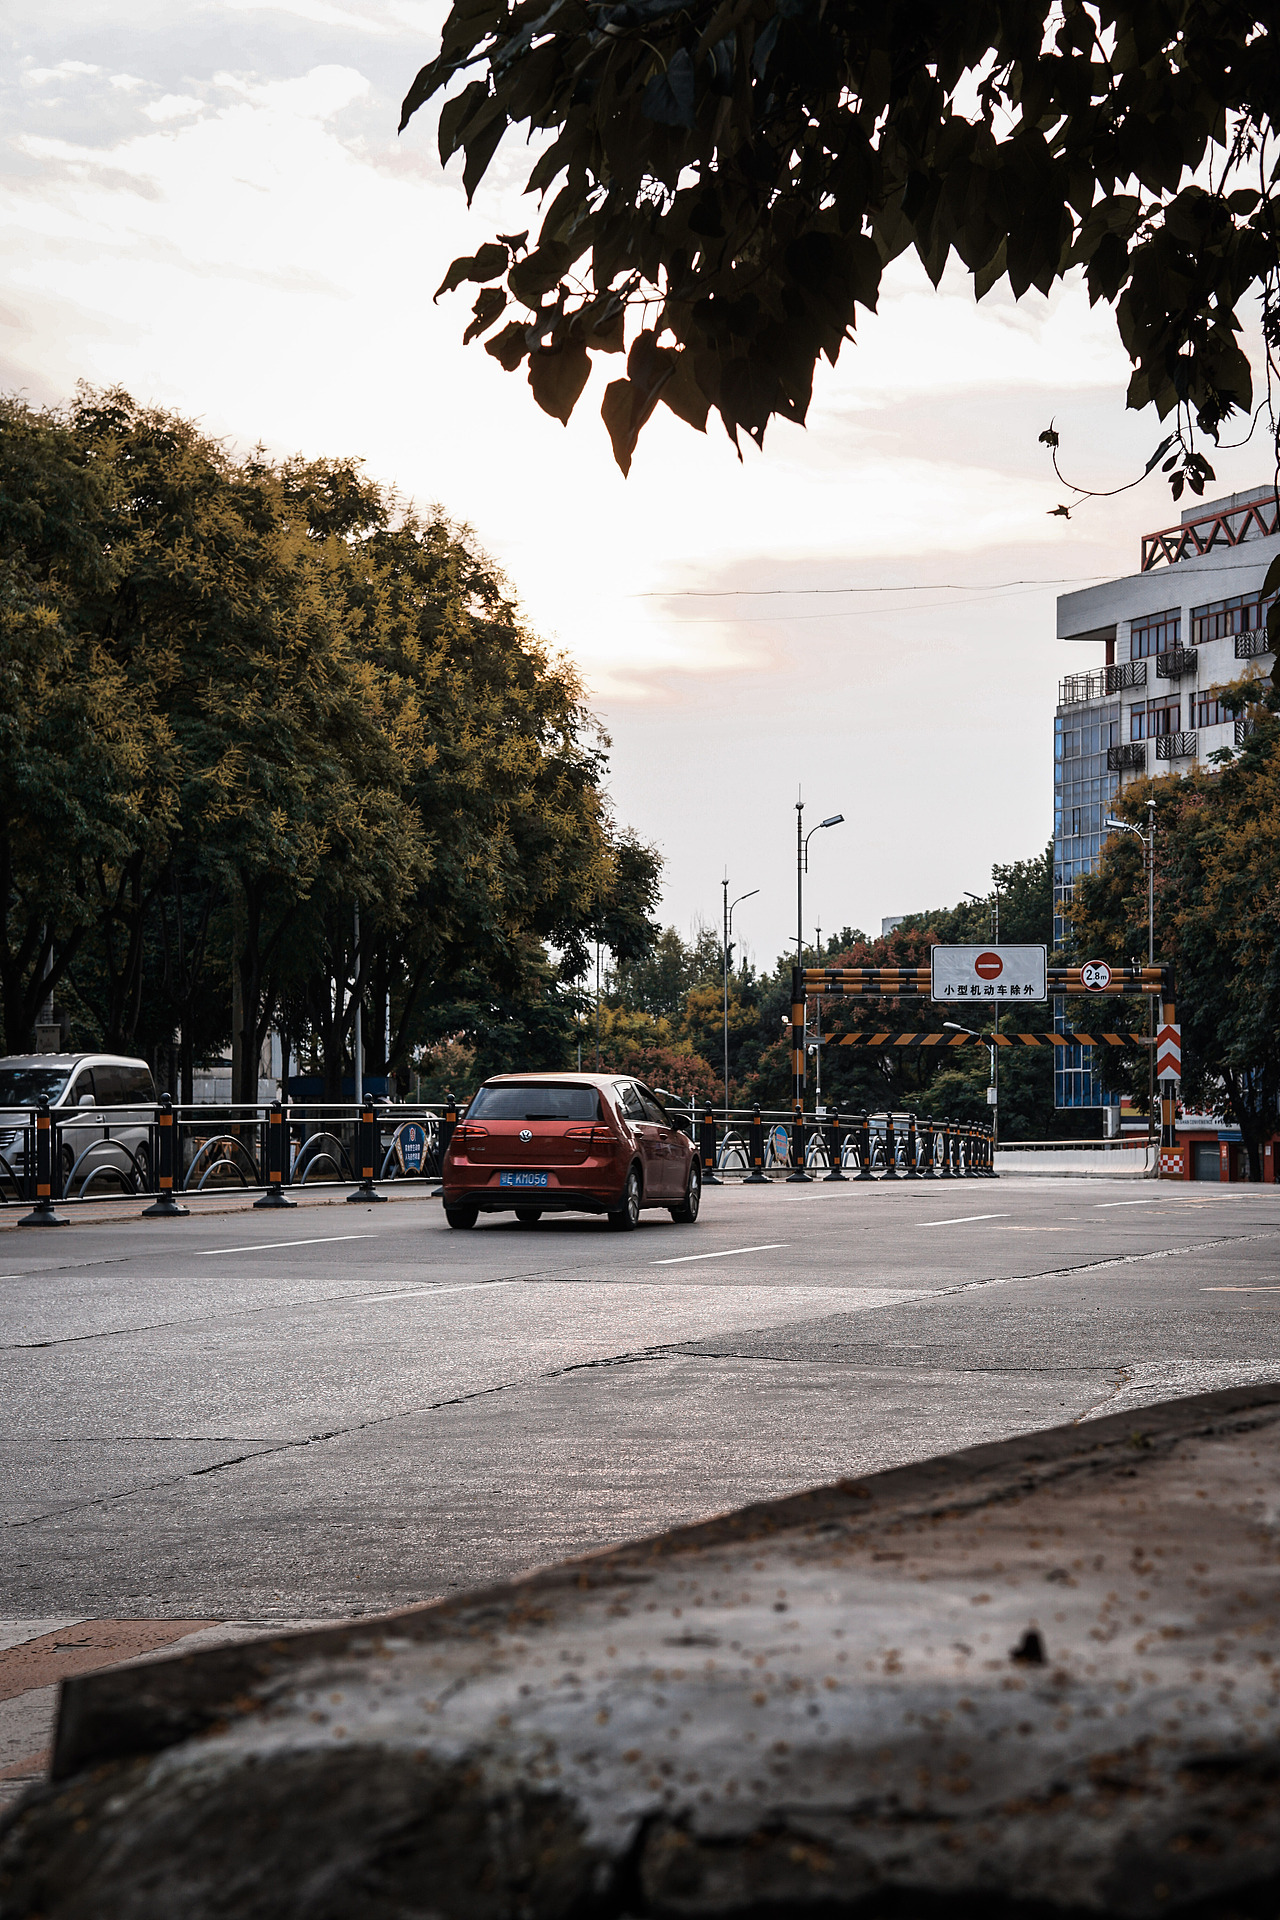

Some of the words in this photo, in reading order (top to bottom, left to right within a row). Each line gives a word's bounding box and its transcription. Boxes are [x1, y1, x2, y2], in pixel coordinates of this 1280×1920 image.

[943, 984, 1035, 996] 小型机动车除外
